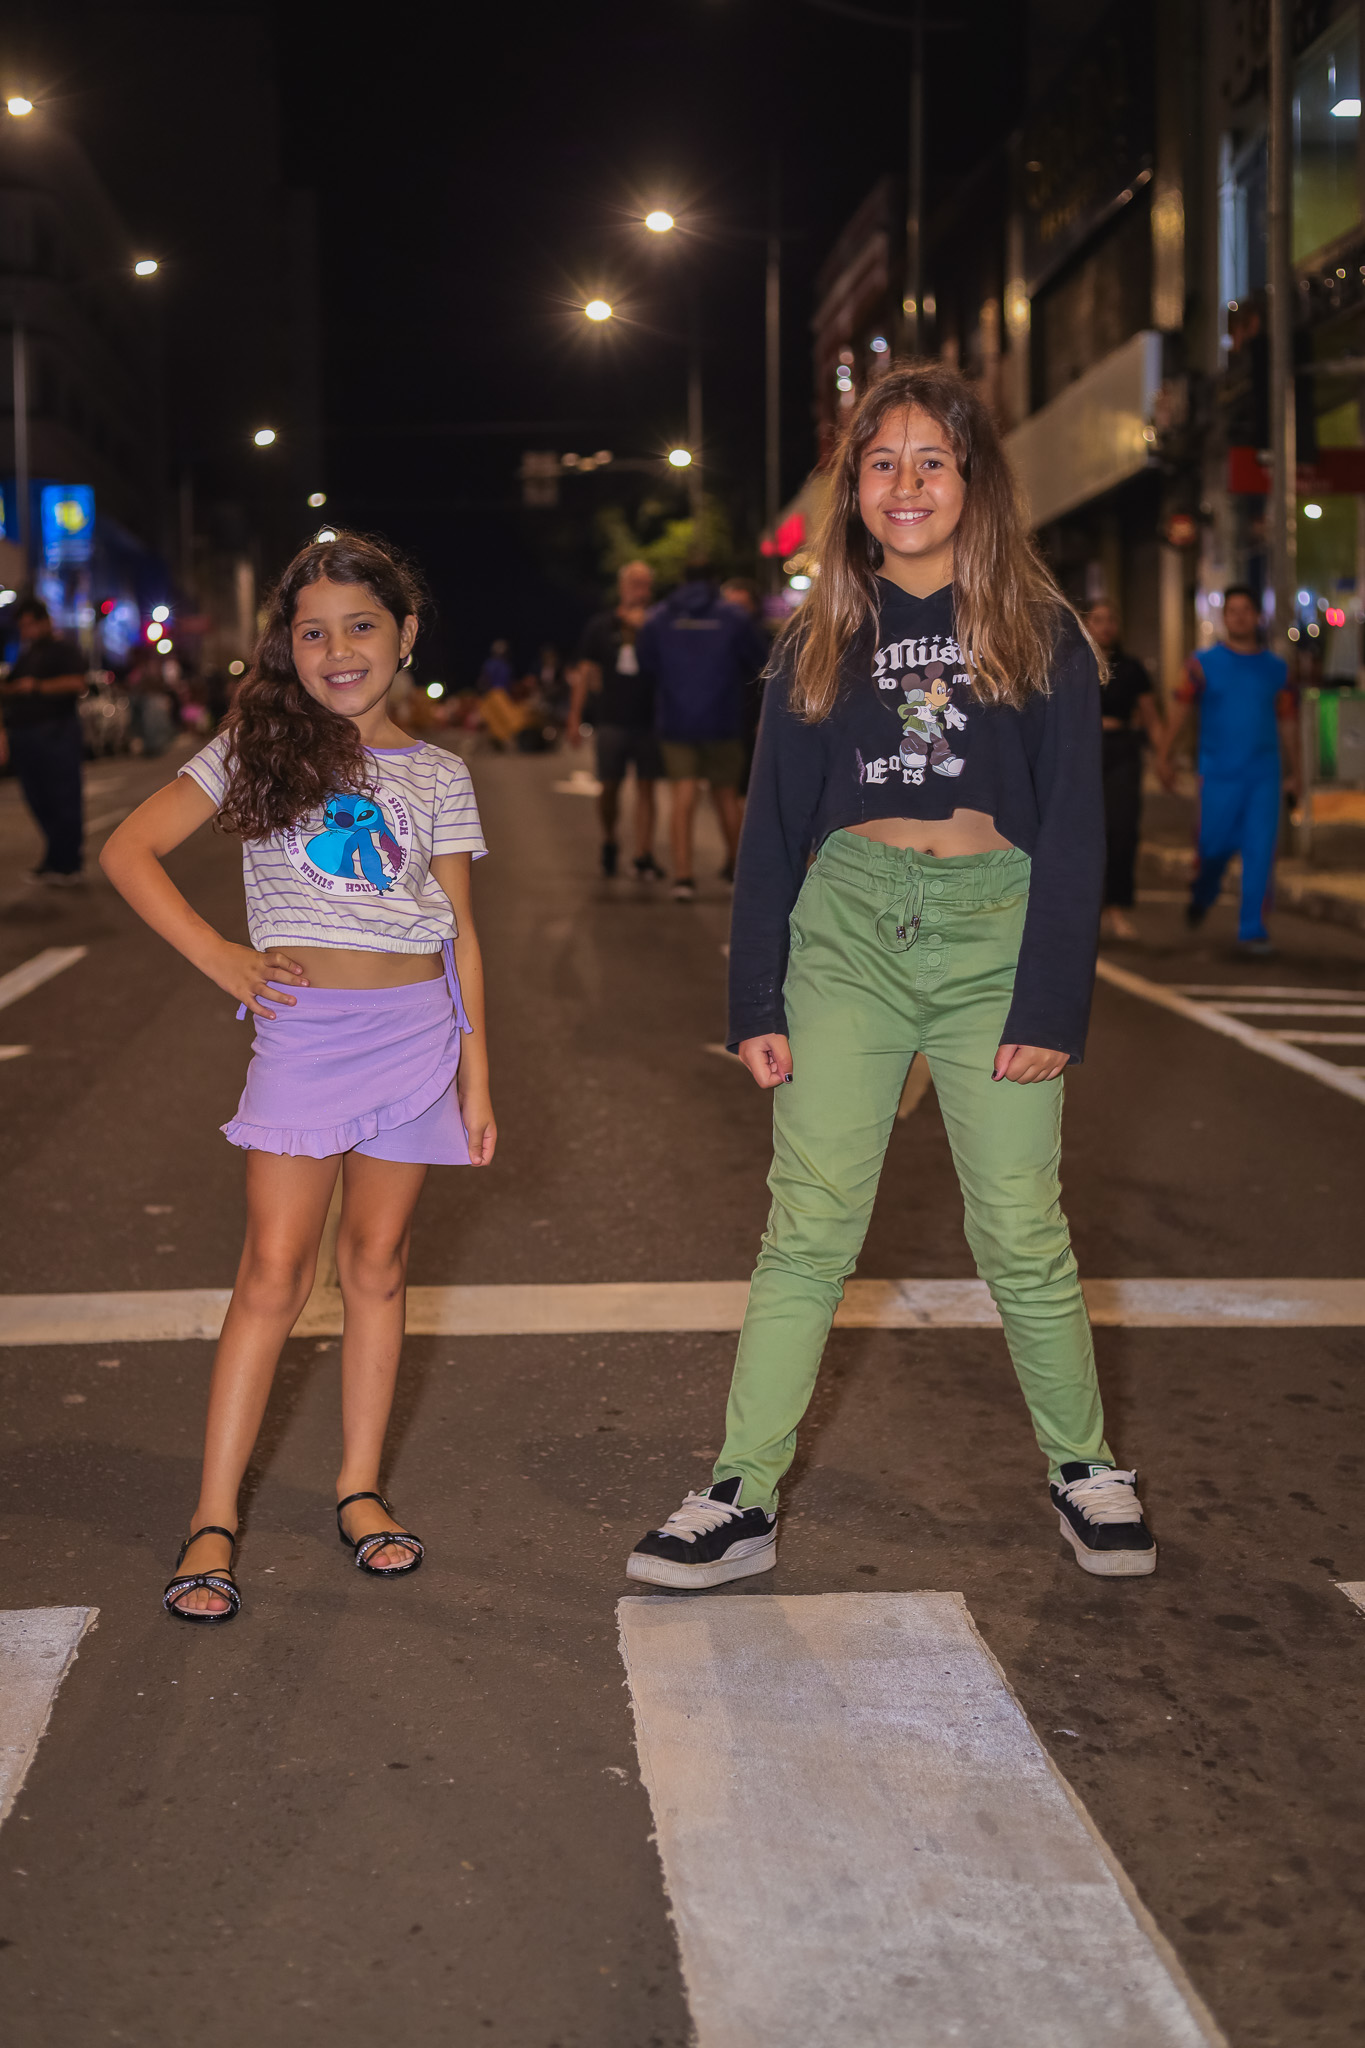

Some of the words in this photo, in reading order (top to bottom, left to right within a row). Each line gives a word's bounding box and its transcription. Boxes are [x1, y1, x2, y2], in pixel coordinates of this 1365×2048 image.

[878, 677, 897, 690] to
[865, 755, 926, 786] Ears
[388, 797, 409, 836] STITCH
[286, 825, 300, 856] STIT
[299, 861, 335, 890] STITCH
[345, 882, 377, 893] TITCH
